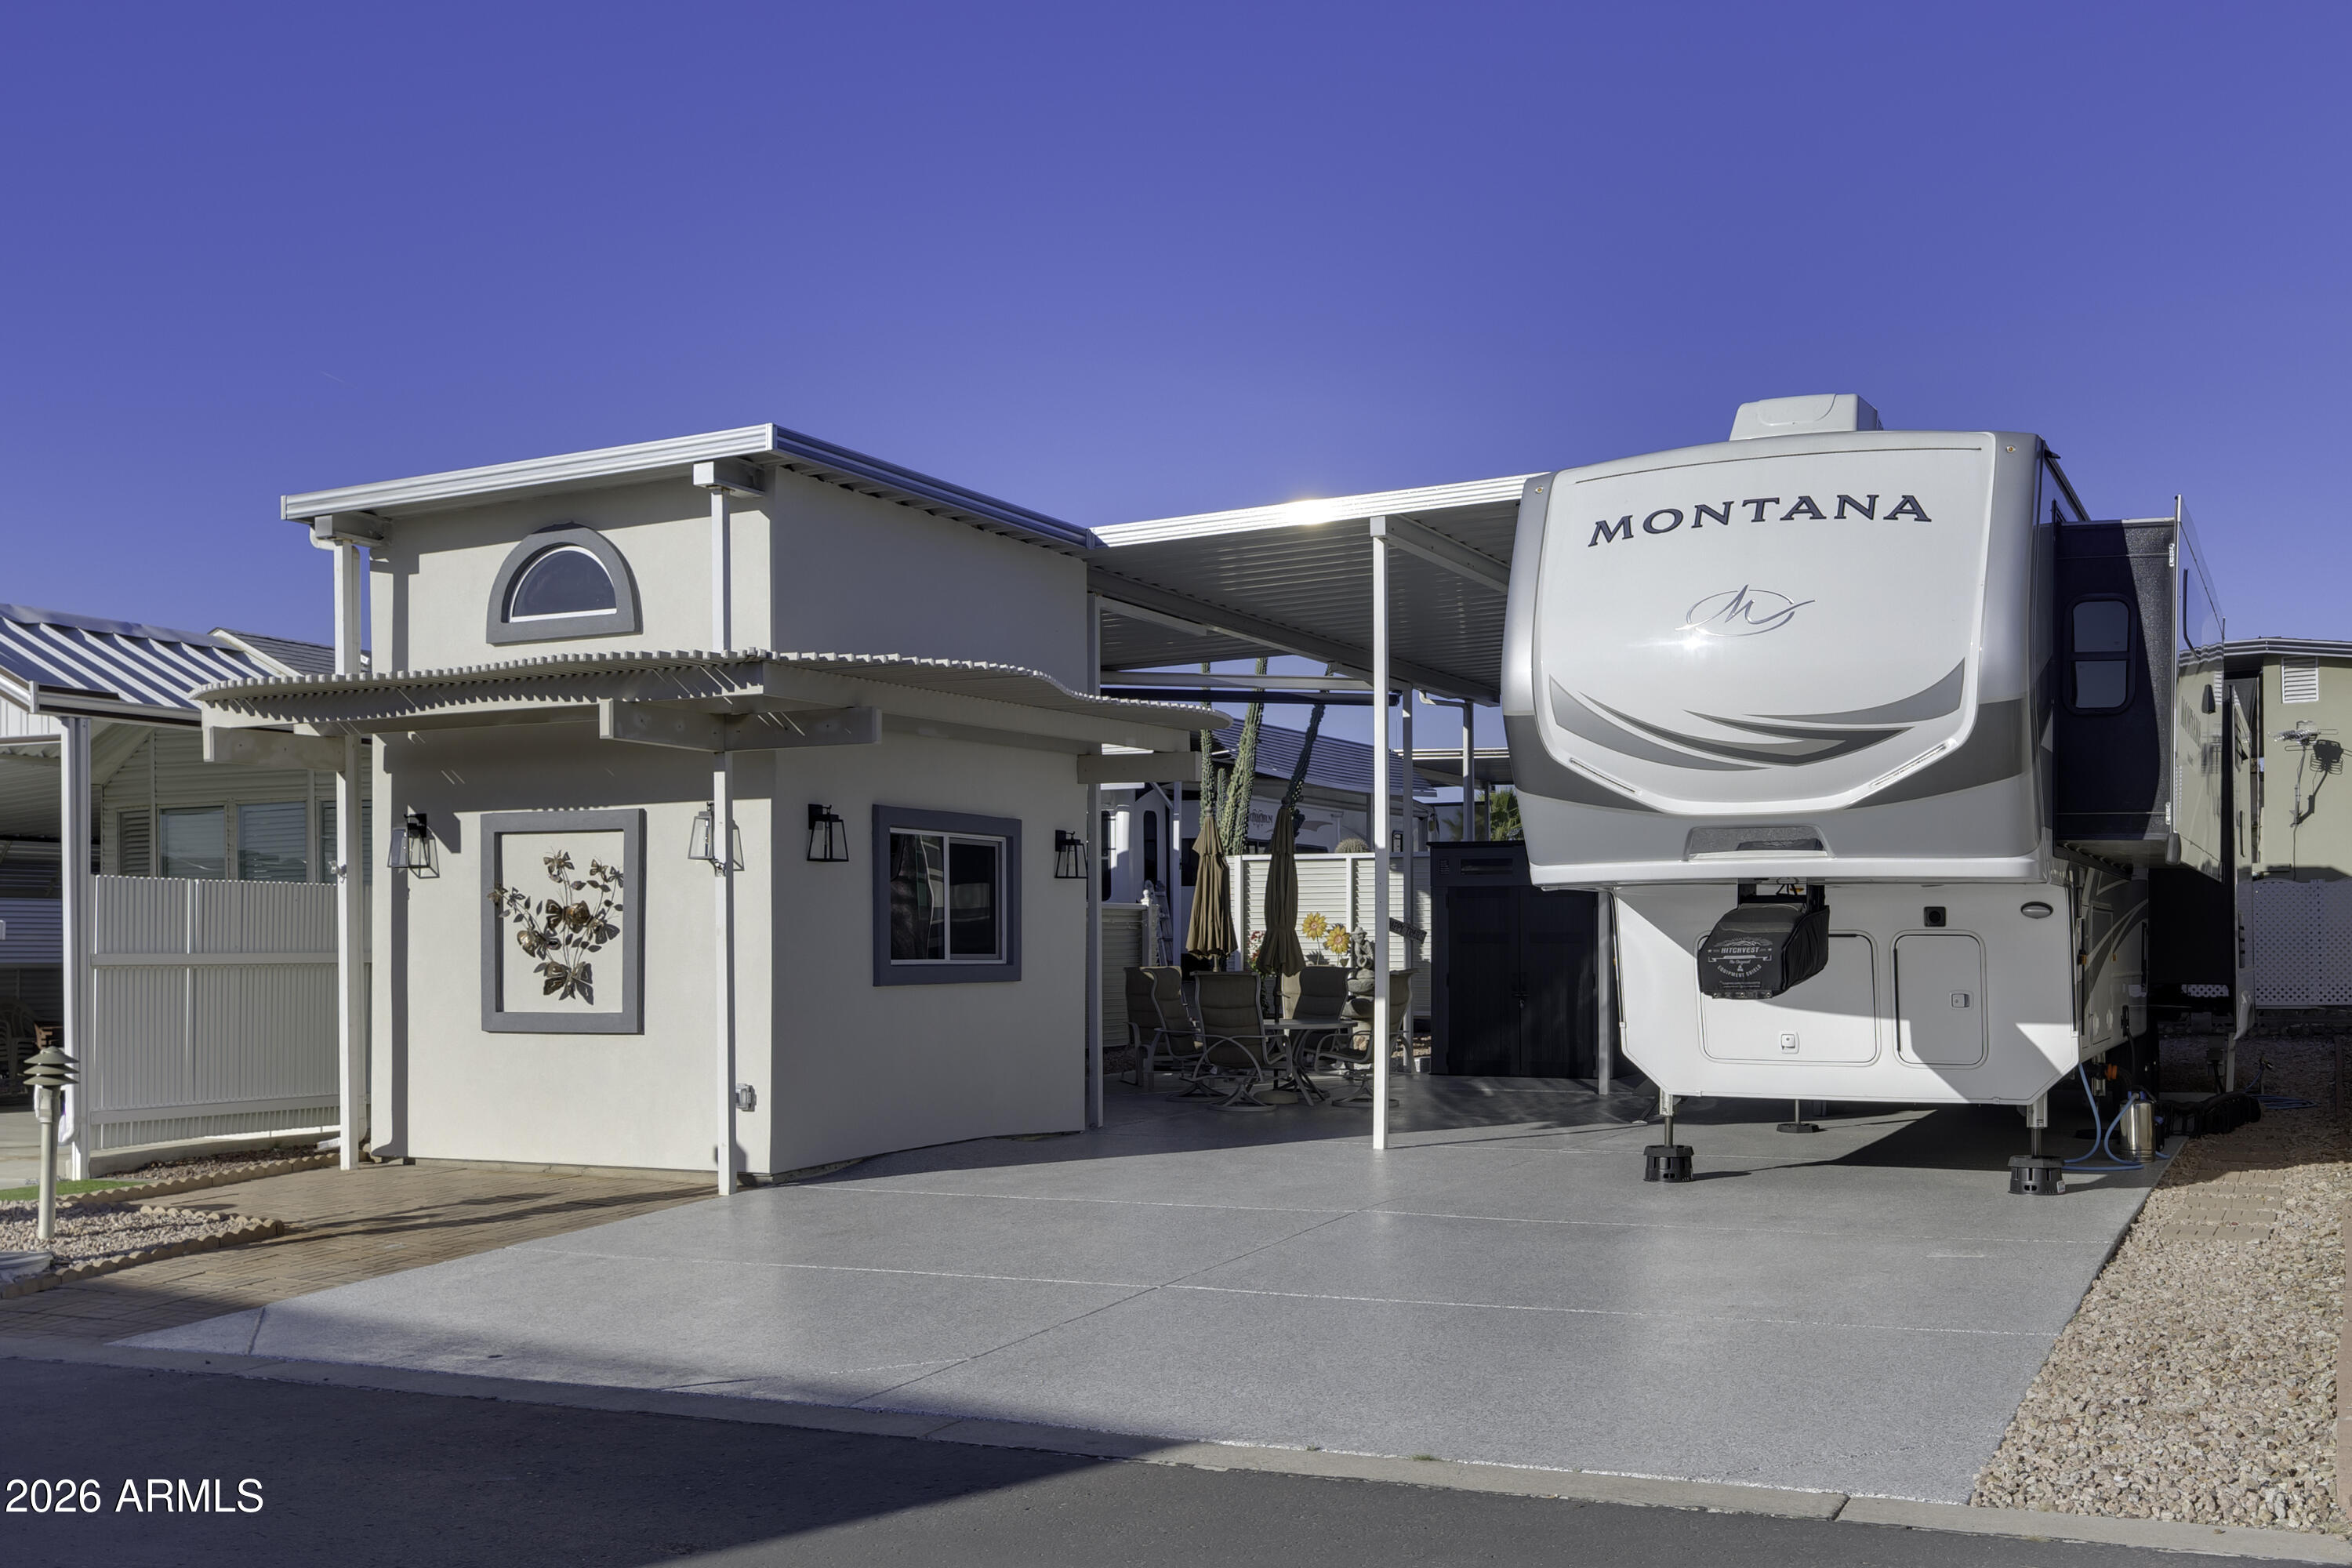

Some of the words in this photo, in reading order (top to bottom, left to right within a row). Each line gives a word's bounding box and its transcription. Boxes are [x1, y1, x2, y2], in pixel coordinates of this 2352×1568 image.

[1588, 493, 1932, 547] MONTANA
[1389, 920, 1405, 933] APPY
[1717, 964, 1745, 978] EQUIPMENT
[1746, 964, 1762, 977] SHIELD
